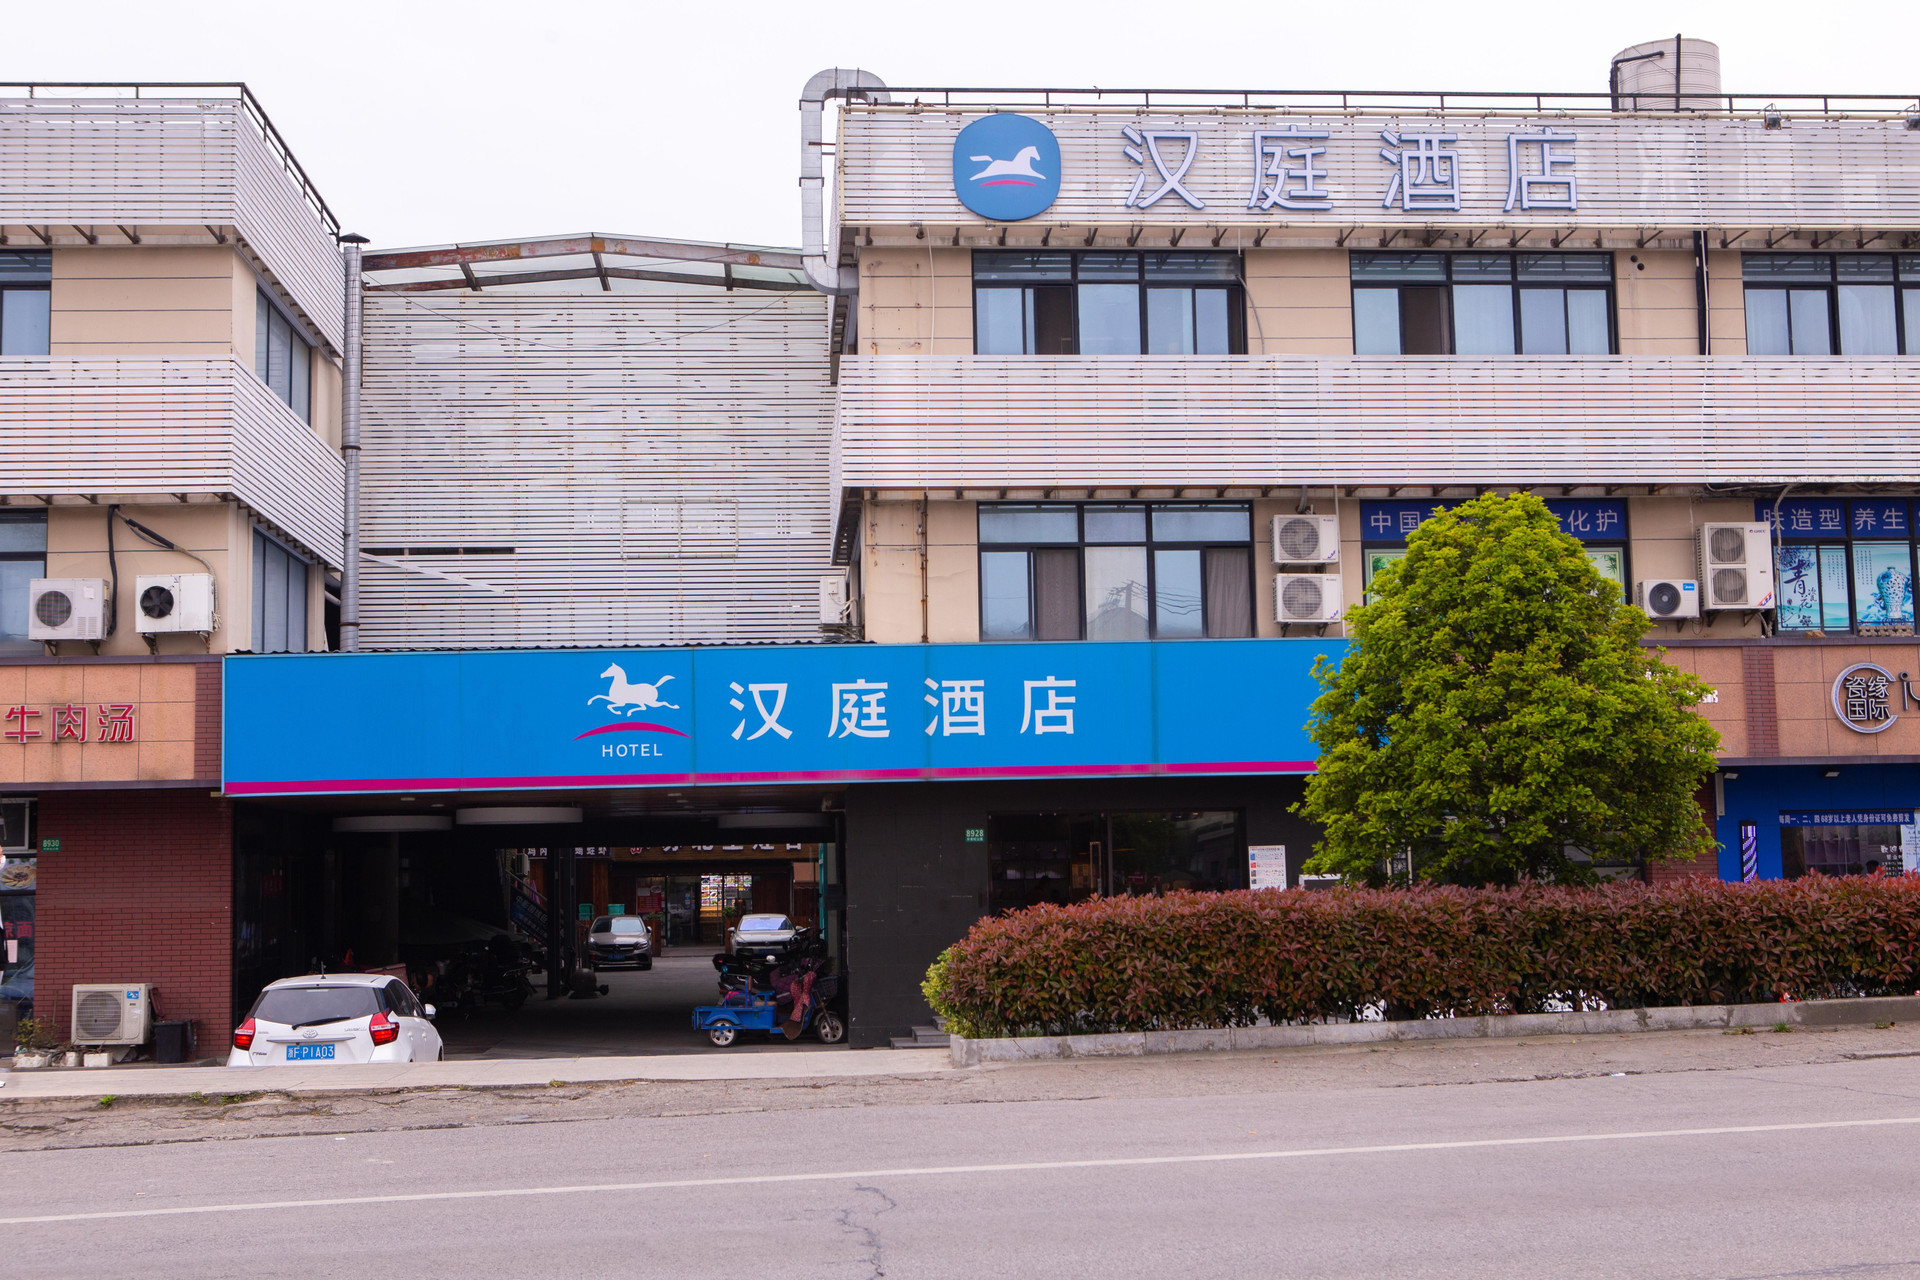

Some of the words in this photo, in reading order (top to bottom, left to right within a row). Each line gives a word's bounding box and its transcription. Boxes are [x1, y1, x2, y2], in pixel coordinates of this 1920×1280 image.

[1122, 124, 1578, 212] 汉庭酒店
[1845, 676, 1890, 698] 瓷缘
[729, 675, 1077, 741] 汉庭酒店
[1846, 699, 1891, 721] 国际
[4, 703, 135, 743] 牛肉汤
[602, 743, 663, 757] HOTEL
[43, 839, 60, 848] 8930
[966, 829, 984, 838] 8928
